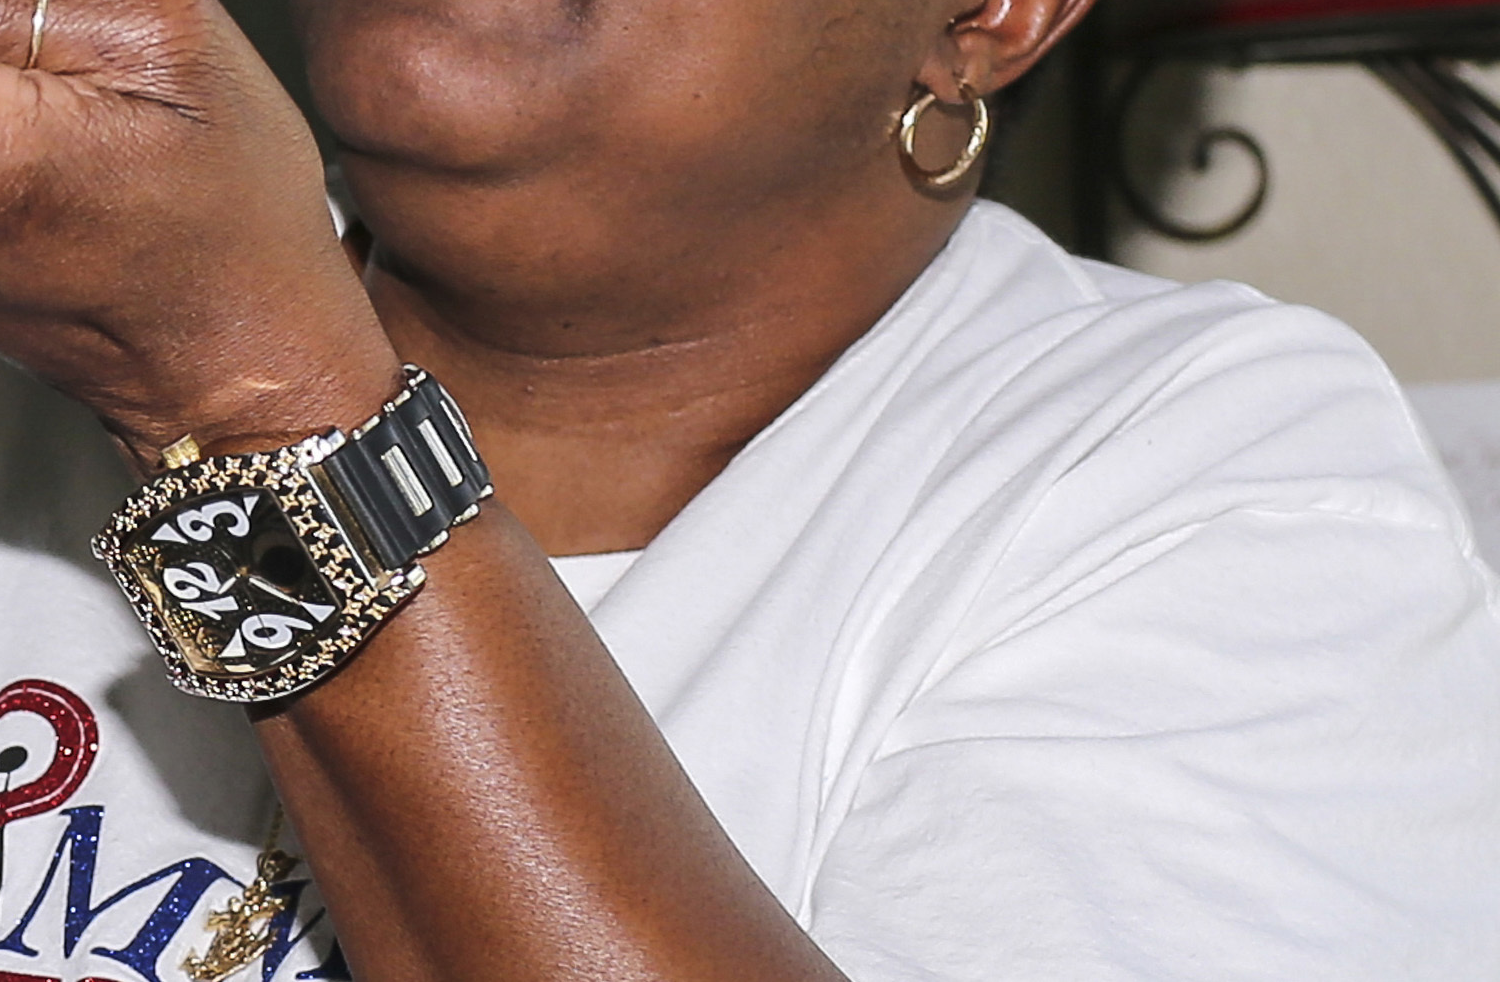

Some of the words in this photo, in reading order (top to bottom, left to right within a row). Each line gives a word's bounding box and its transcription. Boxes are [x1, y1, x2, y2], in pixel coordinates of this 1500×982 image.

[177, 501, 250, 542] 3
[163, 562, 239, 621] 12
[241, 614, 314, 649] 9
